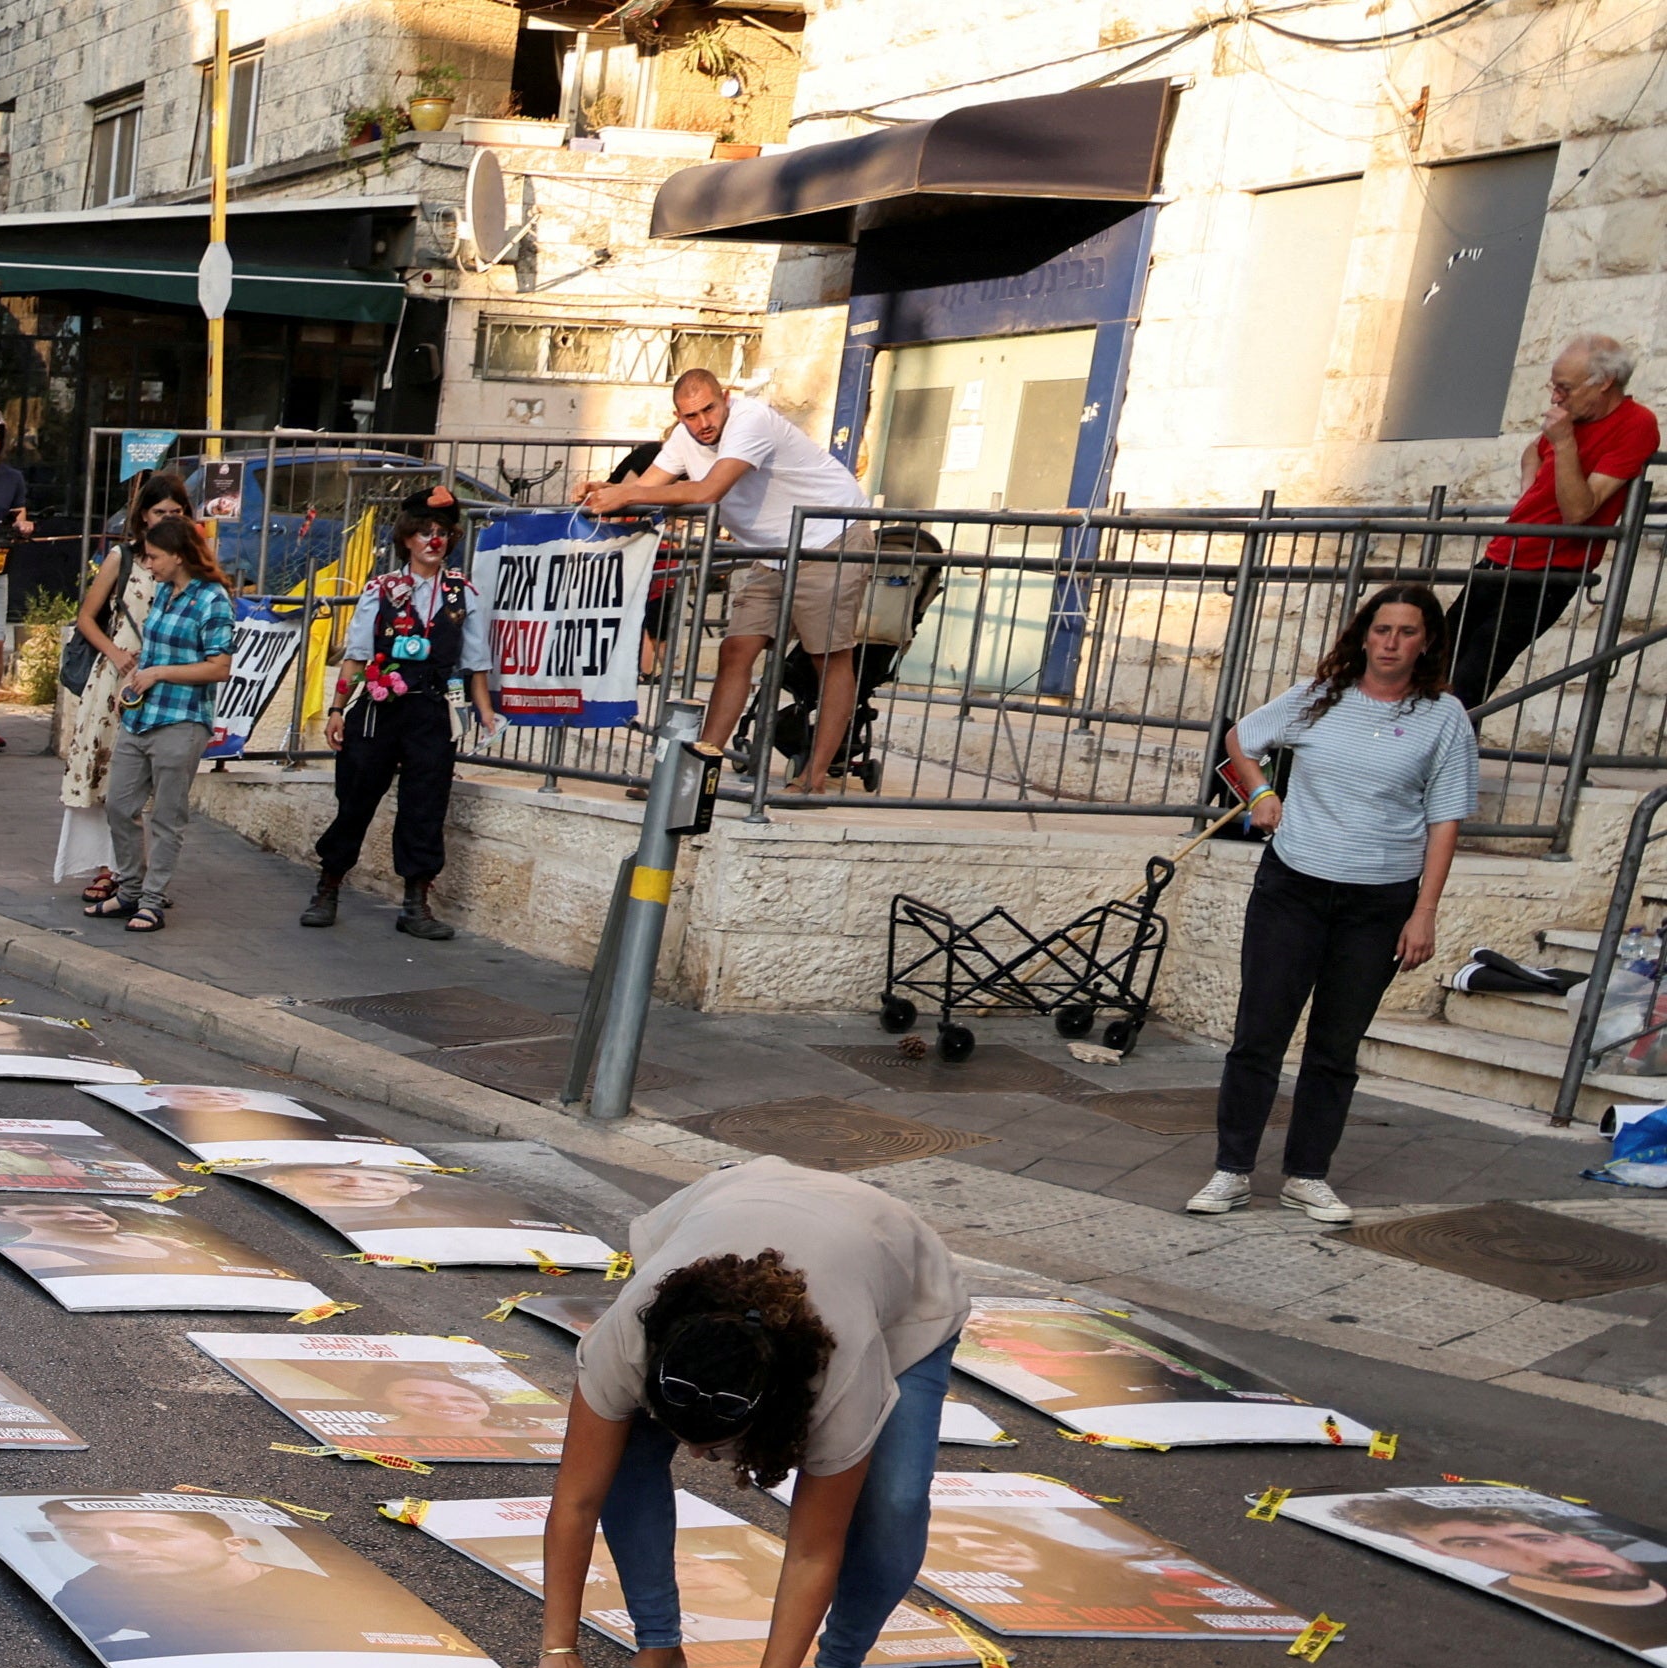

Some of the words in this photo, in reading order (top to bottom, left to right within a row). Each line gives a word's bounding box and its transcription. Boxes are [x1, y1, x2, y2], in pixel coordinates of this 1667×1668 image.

[297, 1408, 389, 1424] BRING
[317, 1422, 378, 1436] HER
[921, 1571, 1025, 1588] BRING
[946, 1587, 1024, 1604] HIM
